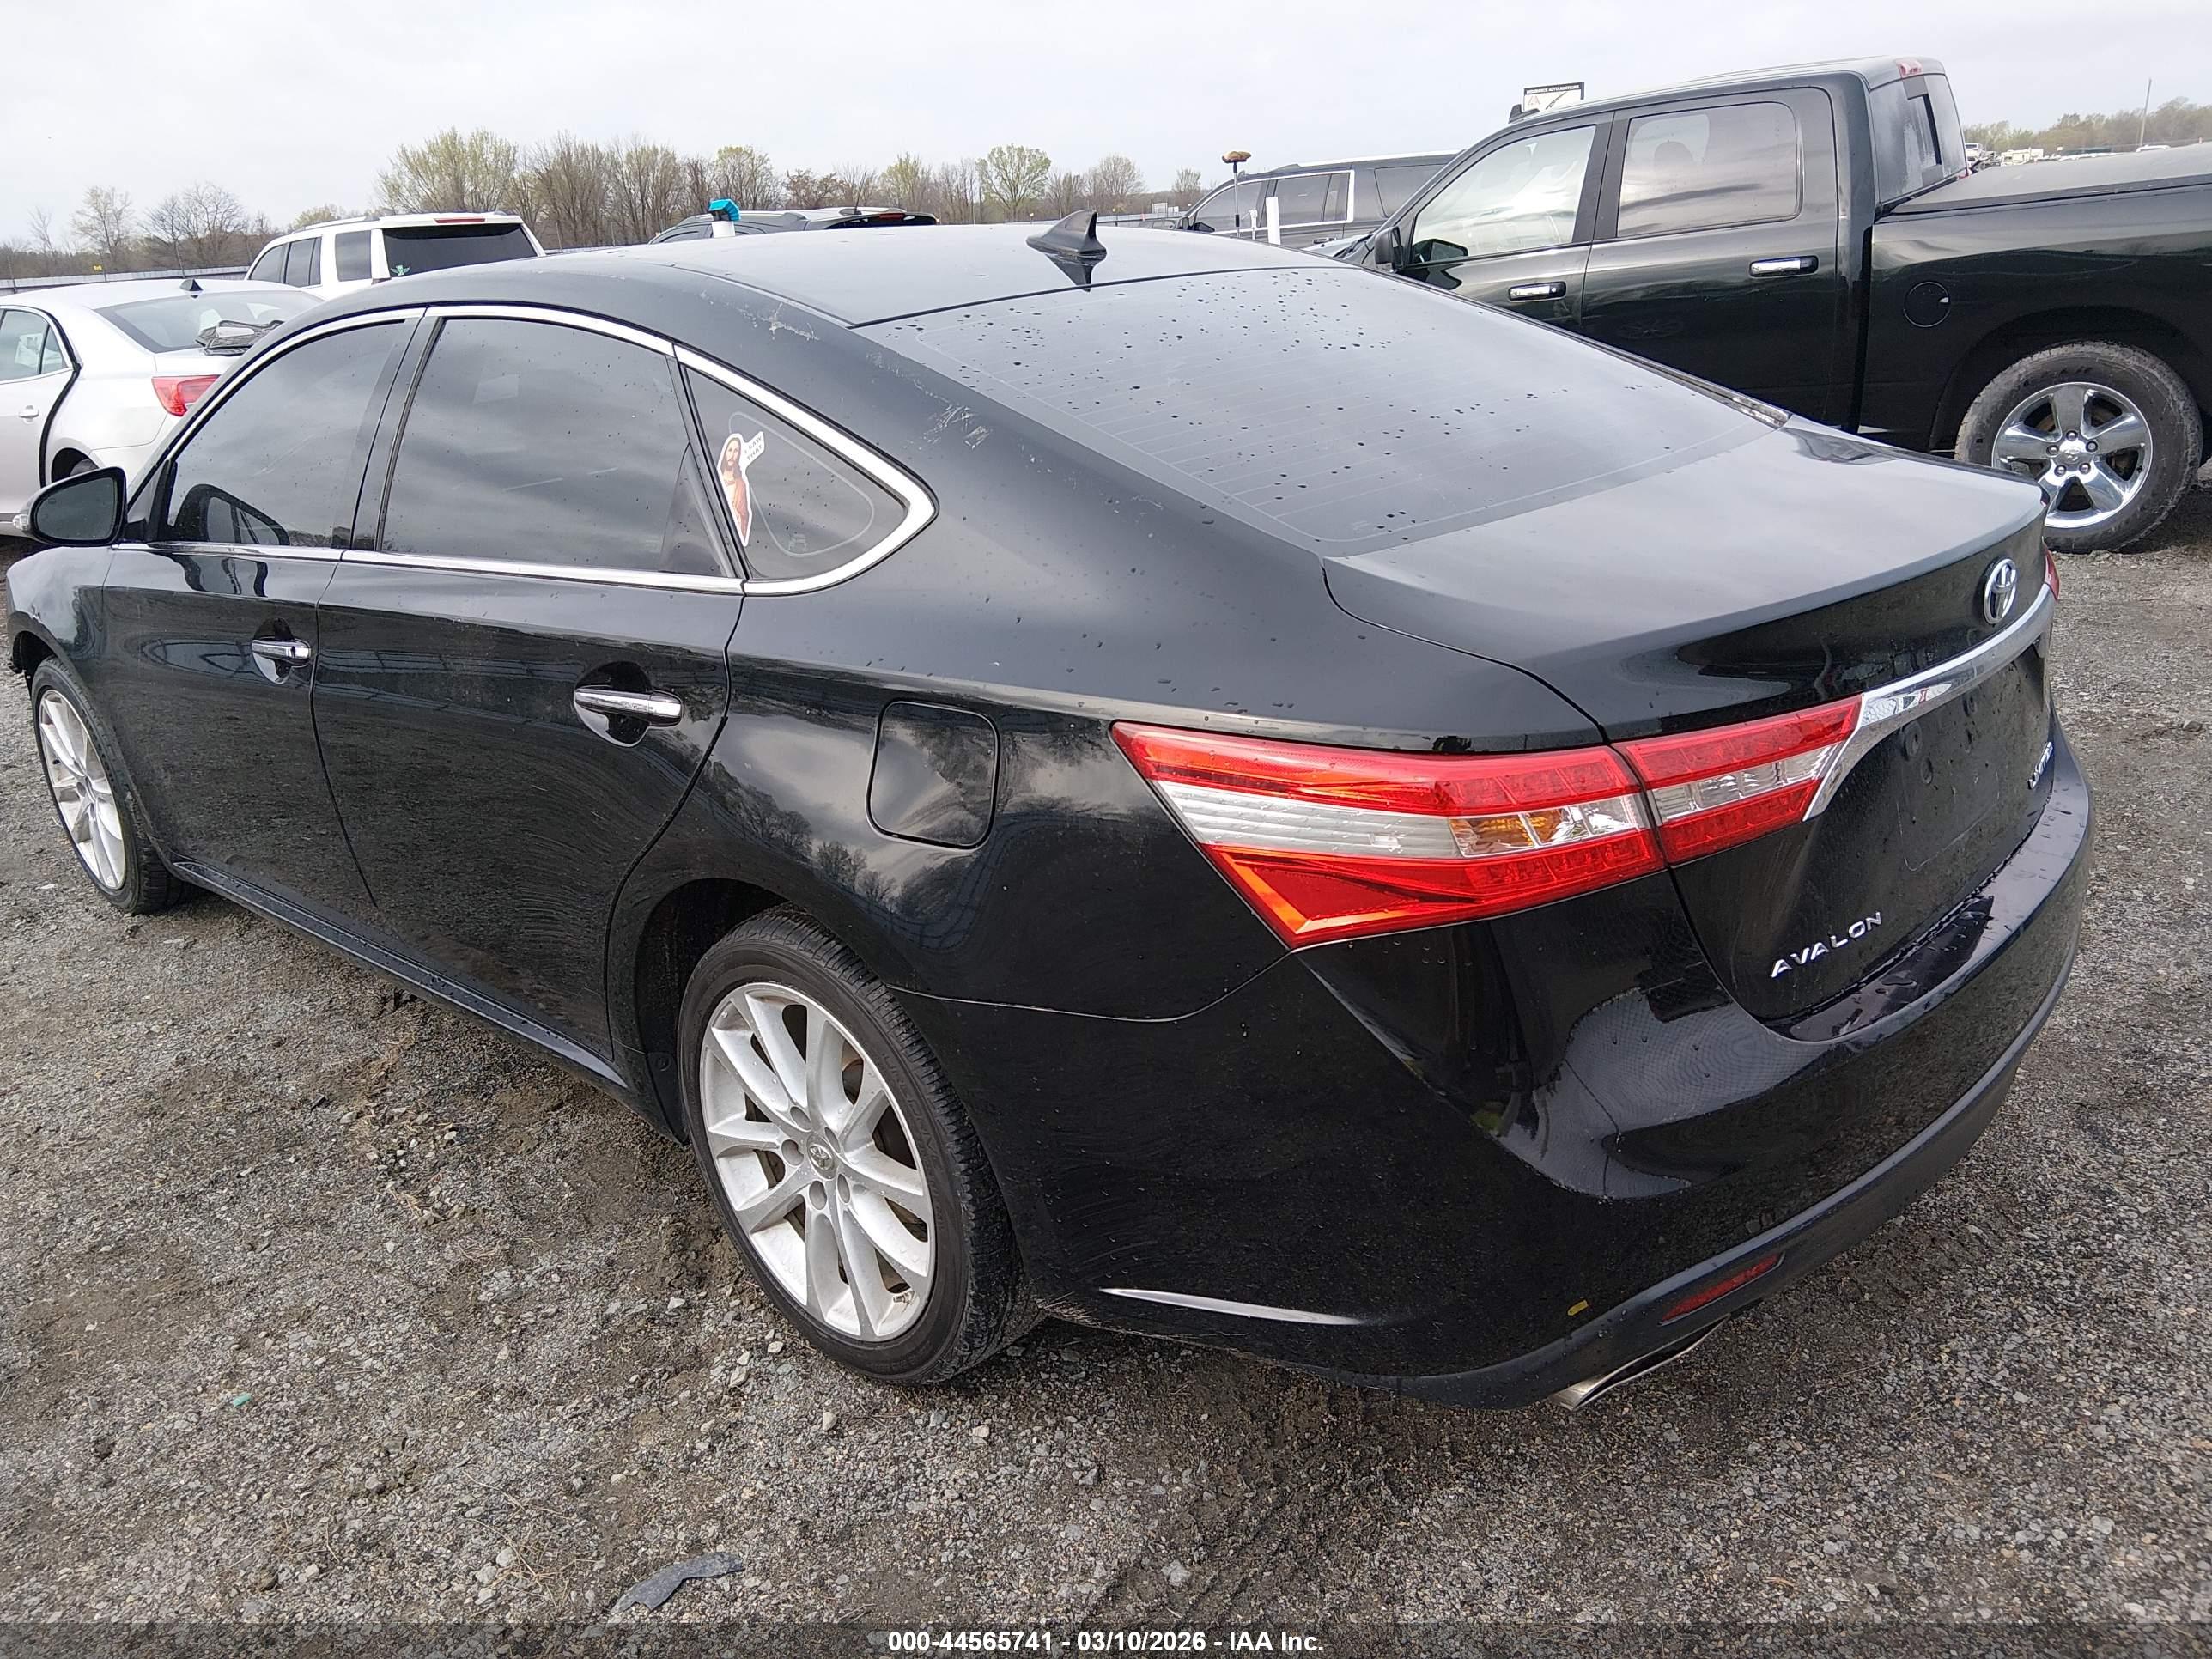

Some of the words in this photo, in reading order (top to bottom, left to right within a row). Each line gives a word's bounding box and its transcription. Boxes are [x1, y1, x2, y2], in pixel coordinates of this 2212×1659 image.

[748, 436, 762, 449] SAW
[747, 444, 763, 460] THAT
[1771, 911, 1881, 978] AVALON
